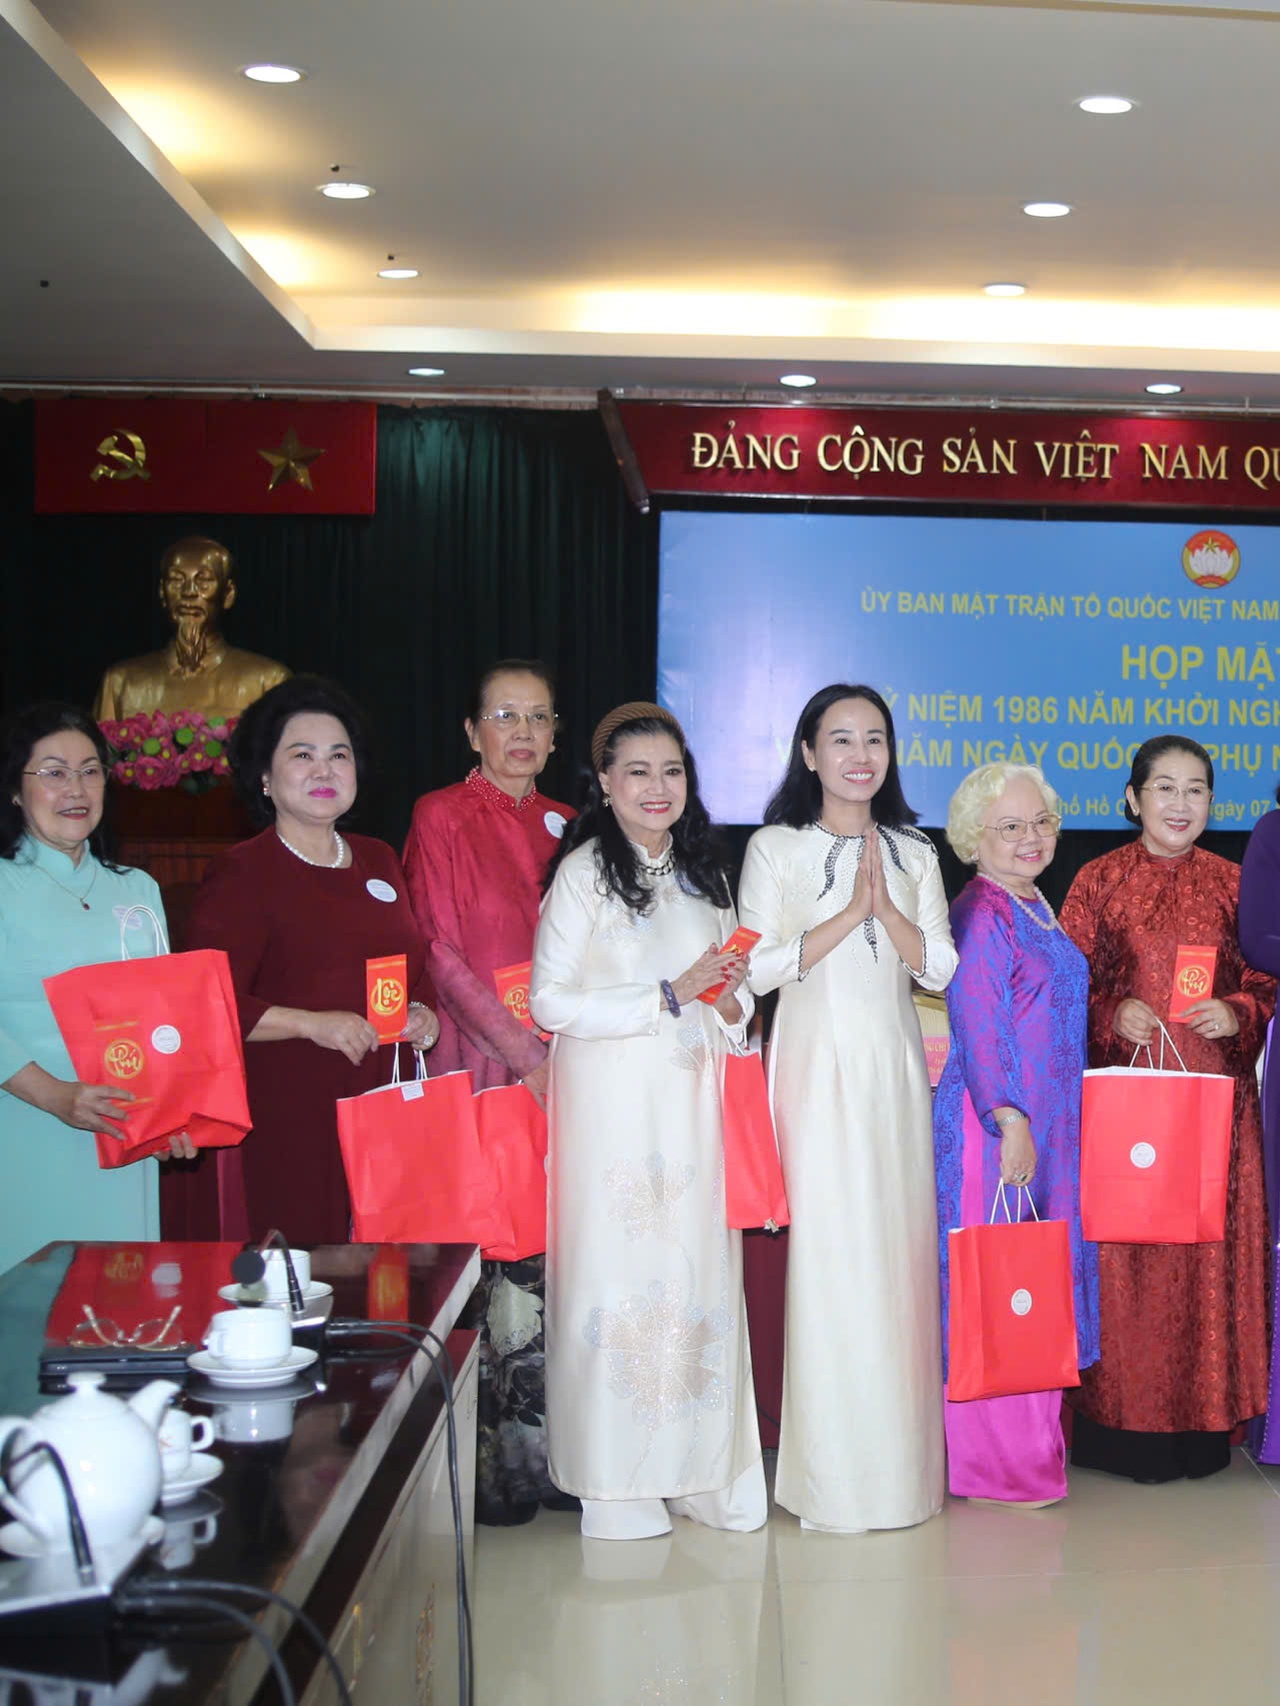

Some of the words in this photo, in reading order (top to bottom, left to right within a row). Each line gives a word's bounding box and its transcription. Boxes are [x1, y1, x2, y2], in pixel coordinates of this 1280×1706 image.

[691, 420, 802, 471] ĐẢNG
[817, 424, 925, 479] CỘNG
[942, 427, 1017, 475] SẢN
[1034, 429, 1120, 481] VIỆT
[1140, 442, 1228, 480] NAM
[861, 586, 891, 613] ỦY
[897, 591, 944, 614] BAN
[1005, 592, 1065, 621] TRẬN
[1071, 592, 1102, 618] TỔ
[1107, 592, 1172, 620] QUỐC
[1178, 595, 1225, 624] VIỆT
[1231, 599, 1279, 622] NAM
[1121, 643, 1206, 690] HỌP
[908, 690, 983, 728] NIỆM
[993, 695, 1058, 724] 1986
[1068, 691, 1135, 724] NĂM
[1144, 692, 1219, 726] KHỞI
[962, 733, 1048, 768] NGÀY
[1058, 793, 1081, 817] hố
